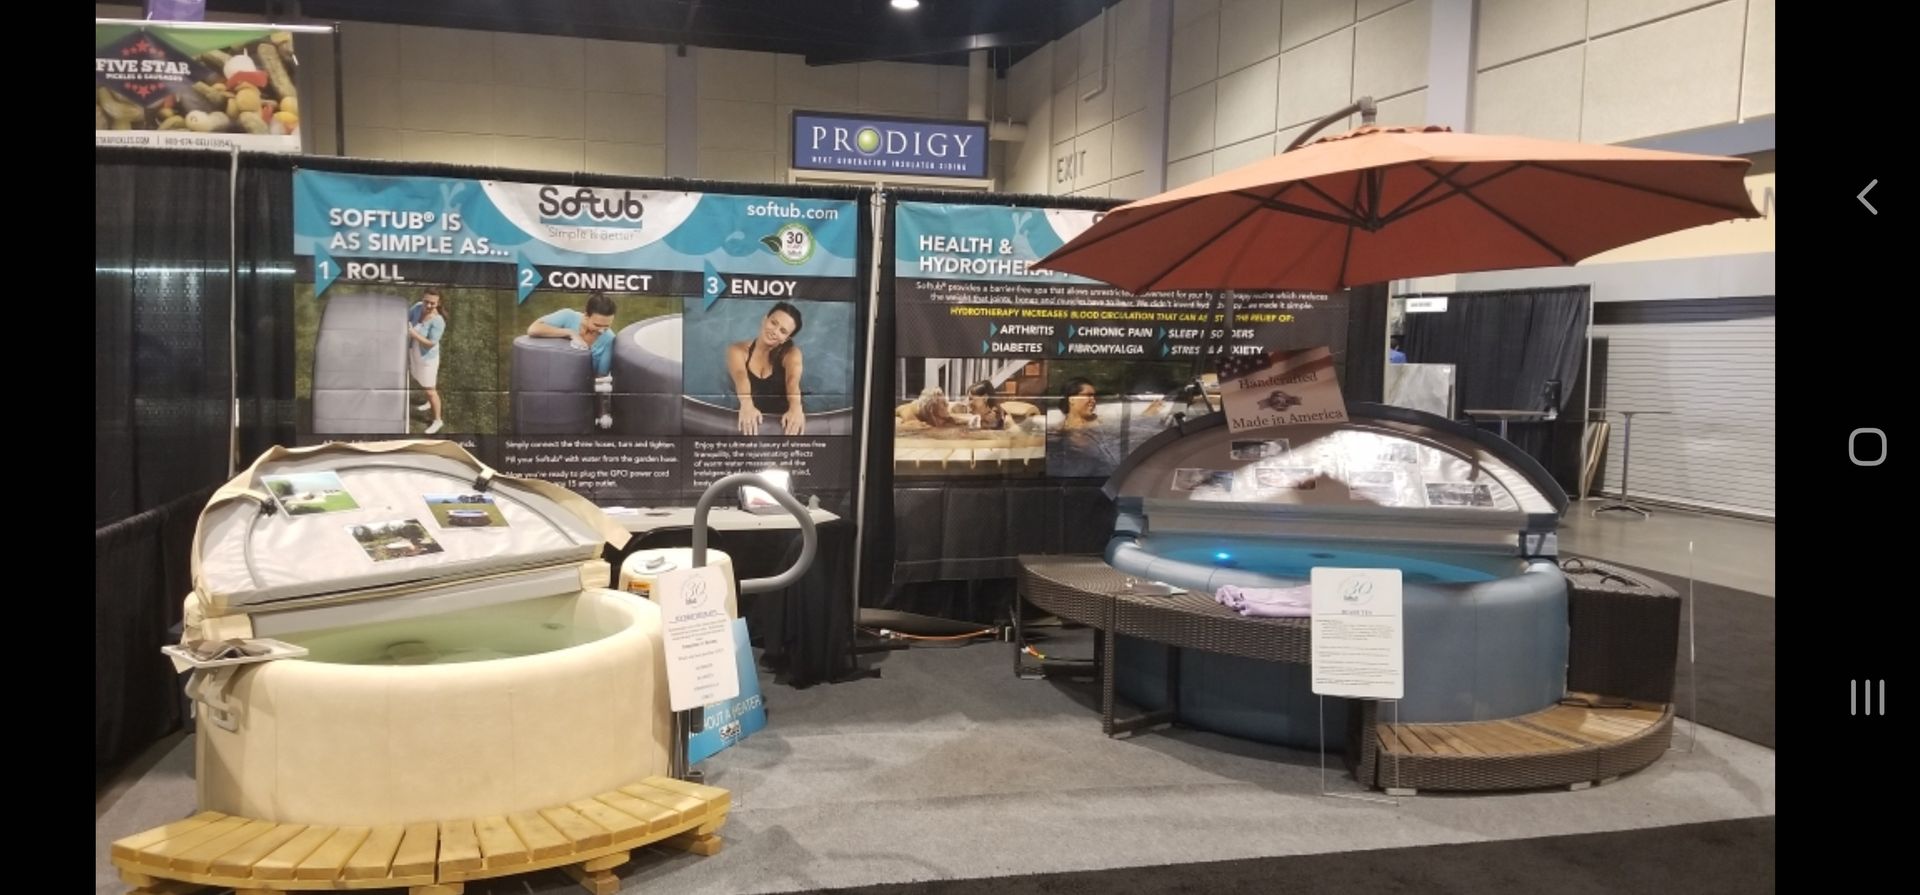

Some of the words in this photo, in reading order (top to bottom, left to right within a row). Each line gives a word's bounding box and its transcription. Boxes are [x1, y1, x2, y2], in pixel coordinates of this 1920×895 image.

[96, 58, 139, 72] FIVE
[141, 60, 191, 75] STAR
[837, 158, 887, 167] GENERATION
[892, 161, 935, 169] INSULATED
[939, 163, 967, 171] SIDING
[1057, 150, 1087, 184] EXIT
[747, 201, 838, 220] softub.com
[441, 212, 462, 231] IS
[329, 232, 360, 250] AS
[368, 233, 453, 254] SIMPLE
[460, 238, 509, 257] AS...
[786, 231, 803, 244] 30
[919, 235, 993, 254] HEALTH
[998, 238, 1013, 255] &
[318, 261, 330, 280] 1
[346, 262, 405, 280] ROLL
[520, 268, 534, 287] 2
[548, 271, 653, 292] CONNECT
[706, 276, 719, 294] 3
[731, 279, 798, 297] ENJOY
[950, 306, 1019, 317] HYDROTHERAPY
[1022, 309, 1068, 318] INCREASES
[1071, 311, 1099, 319] BLOOD
[1101, 311, 1155, 320] CIRCULATION
[1156, 312, 1178, 320] THAT
[1179, 313, 1196, 321] CAN
[1000, 324, 1055, 336] ARTHRITIS
[1077, 326, 1125, 337] CHRONIC
[1128, 327, 1153, 338] PAIN
[1167, 328, 1199, 339] SLEEP
[992, 342, 1043, 353] DIABETES
[1068, 343, 1144, 355] FIBROMYALGIA
[1238, 371, 1319, 390] Handcrafted
[1232, 415, 1270, 429] Made
[1271, 414, 1285, 426] in
[1289, 408, 1343, 424] America
